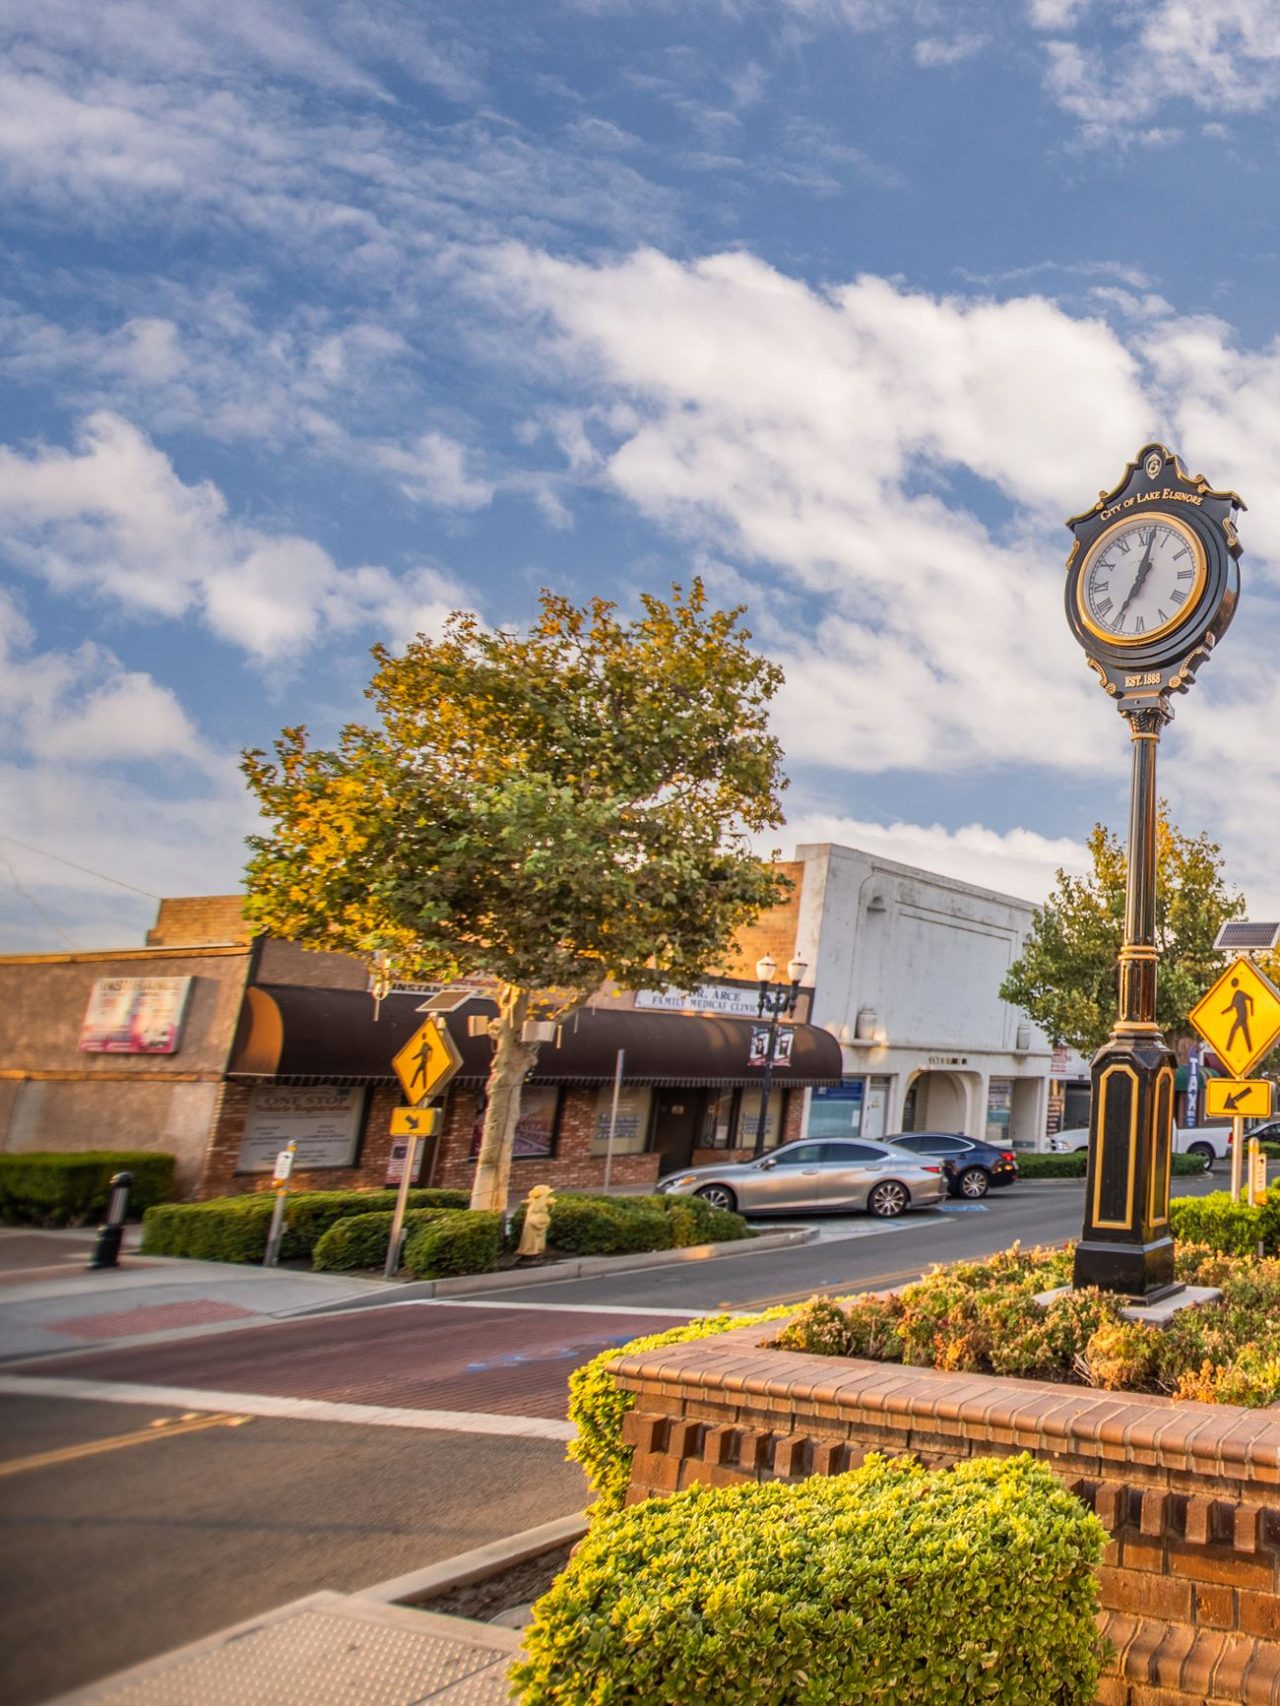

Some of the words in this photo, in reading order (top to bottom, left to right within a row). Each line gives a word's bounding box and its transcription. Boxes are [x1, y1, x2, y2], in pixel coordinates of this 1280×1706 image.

[1100, 504, 1121, 520] CITY
[1123, 497, 1135, 508] OF
[1136, 491, 1161, 503] LAKE
[1162, 488, 1203, 506] ELSINORE
[1125, 674, 1143, 687] EST.
[1143, 672, 1161, 685] 1888
[714, 990, 741, 1001] ARCE
[690, 999, 727, 1009] MEDICAL
[264, 1096, 300, 1105] ONE
